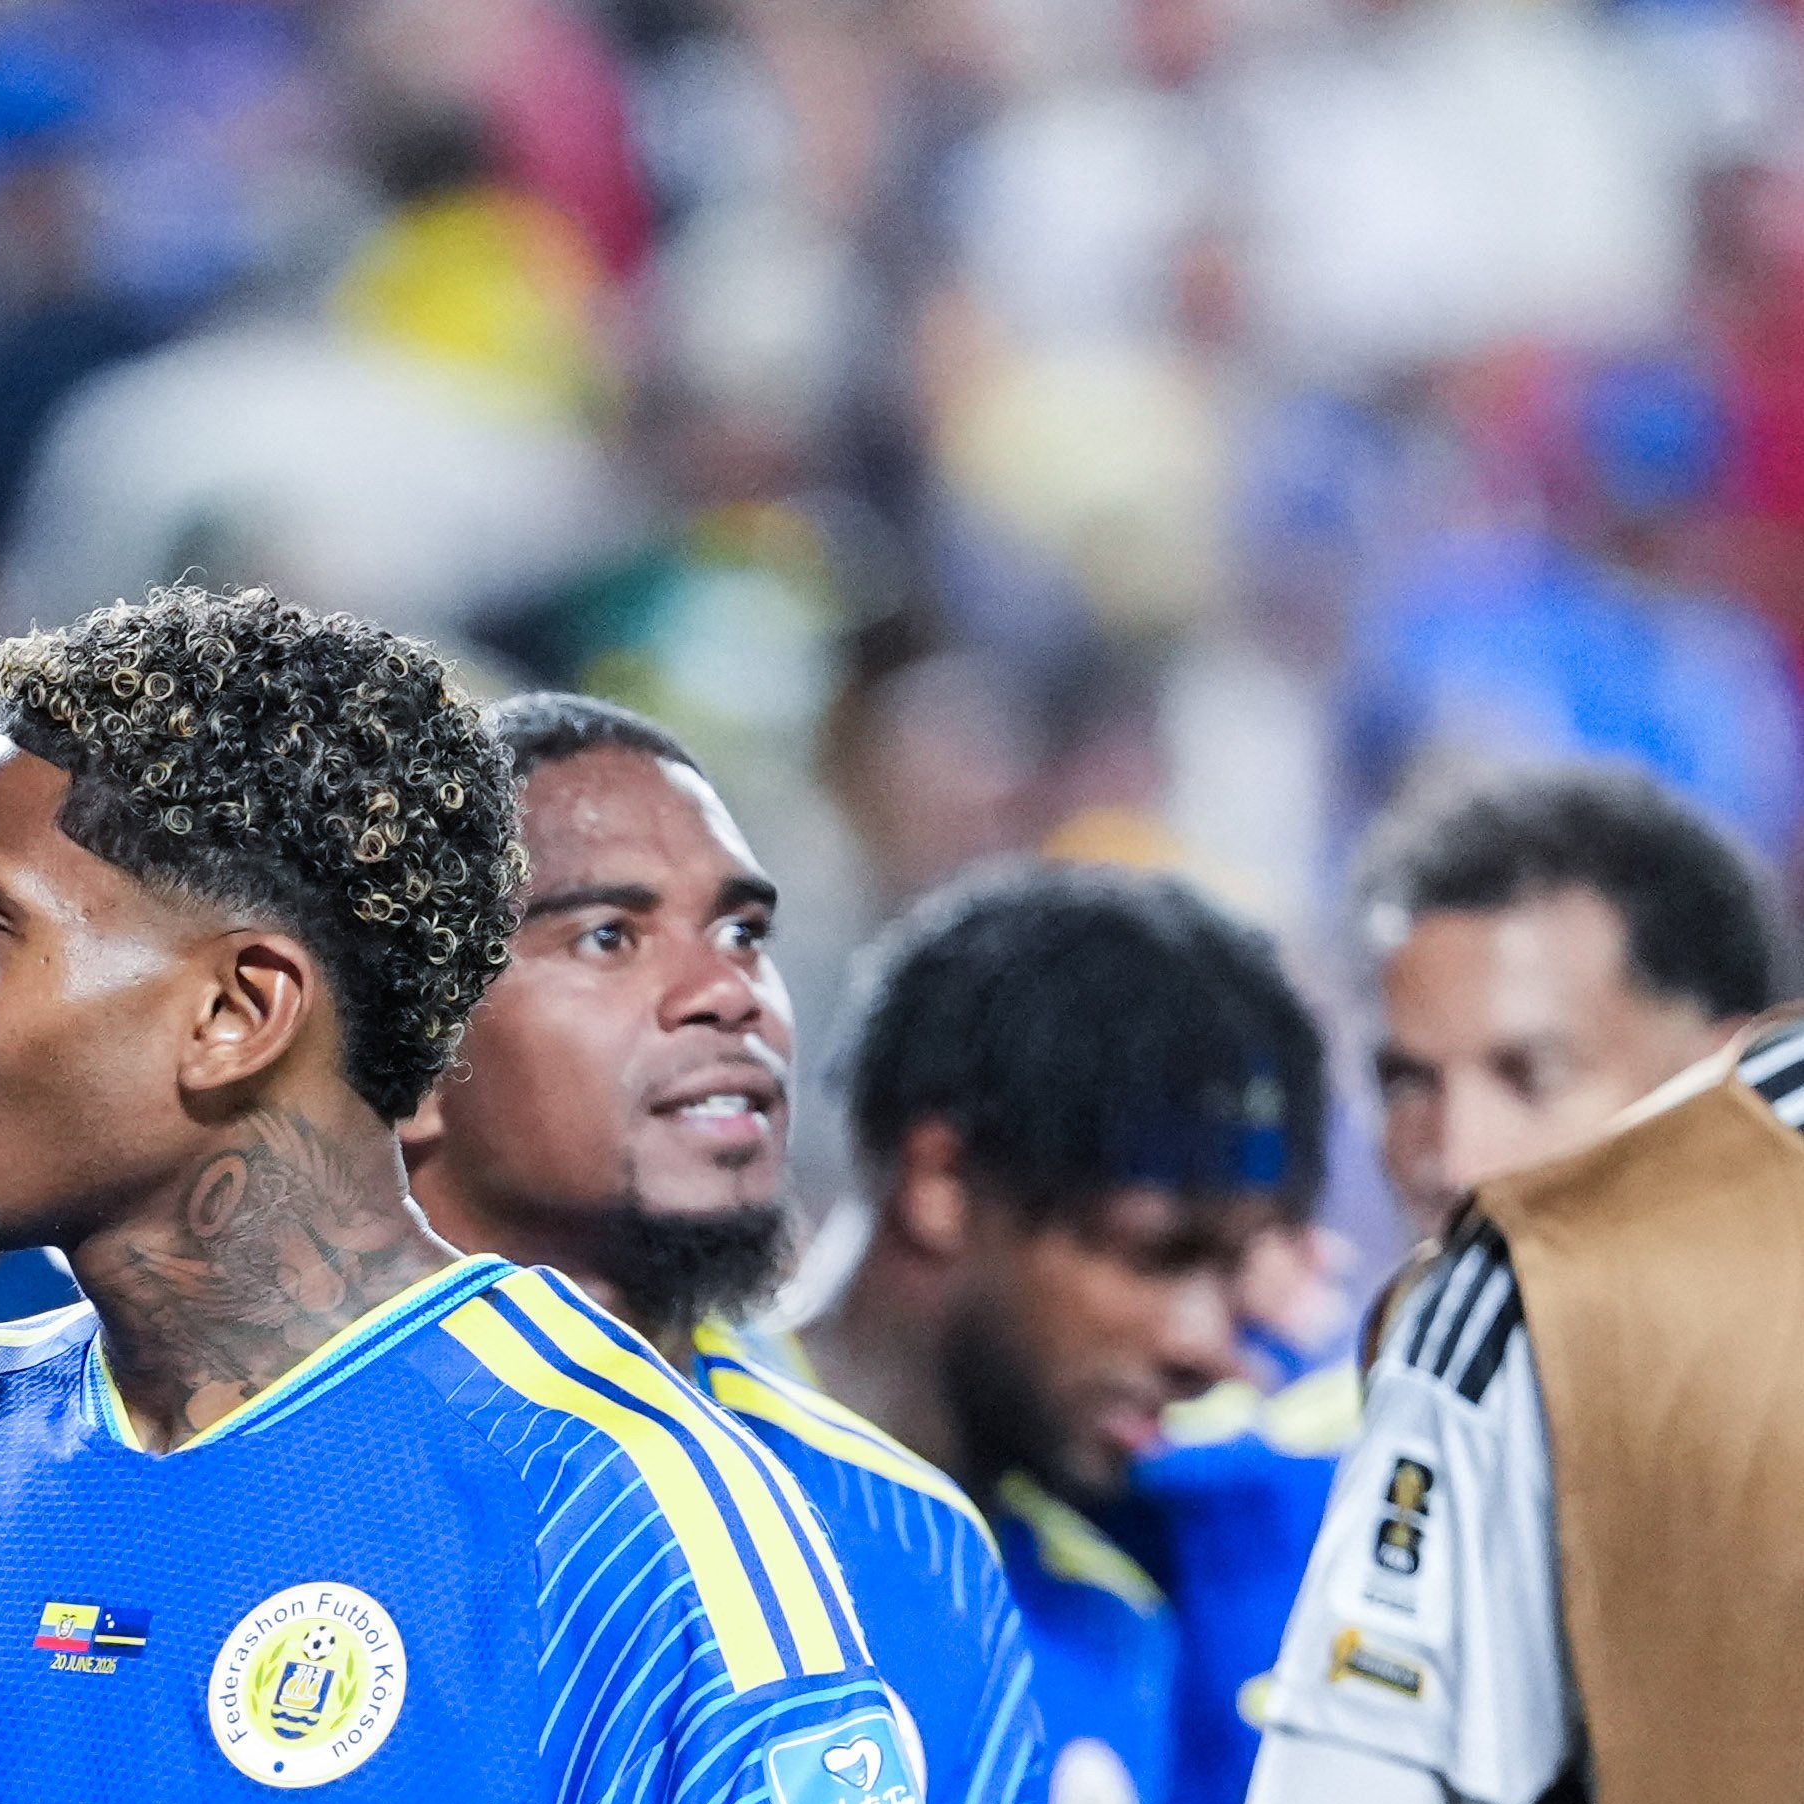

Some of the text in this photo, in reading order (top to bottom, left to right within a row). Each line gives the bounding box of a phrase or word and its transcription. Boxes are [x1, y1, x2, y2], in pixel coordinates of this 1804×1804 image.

[50, 1653, 119, 1675] 20 JUNE 2026
[219, 1599, 306, 1745] Federashon
